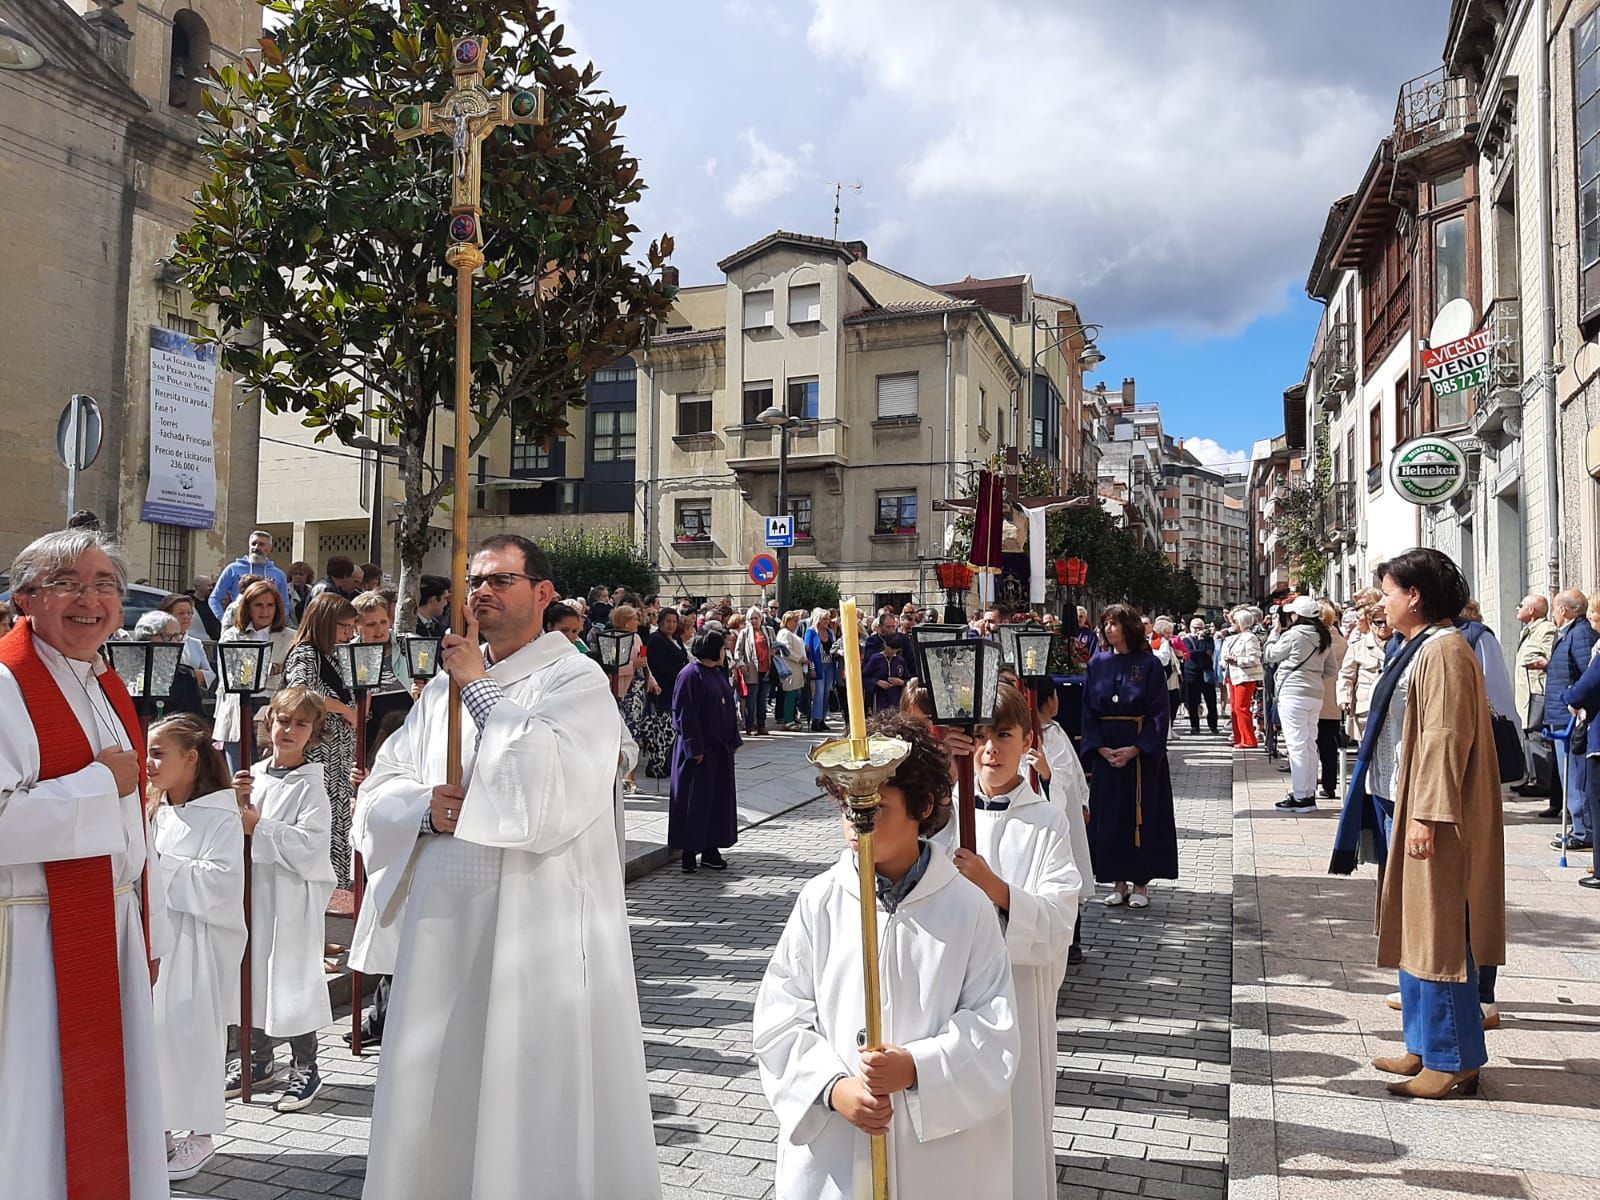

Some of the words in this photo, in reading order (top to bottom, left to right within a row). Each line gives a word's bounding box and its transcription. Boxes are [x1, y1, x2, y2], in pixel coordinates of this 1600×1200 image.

[1435, 377, 1458, 396] 985
[1457, 373, 1475, 389] 72
[154, 388, 181, 402] Necesita
[181, 395, 189, 404] tu
[154, 402, 169, 413] Fase
[185, 433, 212, 448] Principal
[154, 445, 175, 457] Precio
[175, 449, 183, 458] de
[1401, 465, 1456, 476] Heineken
